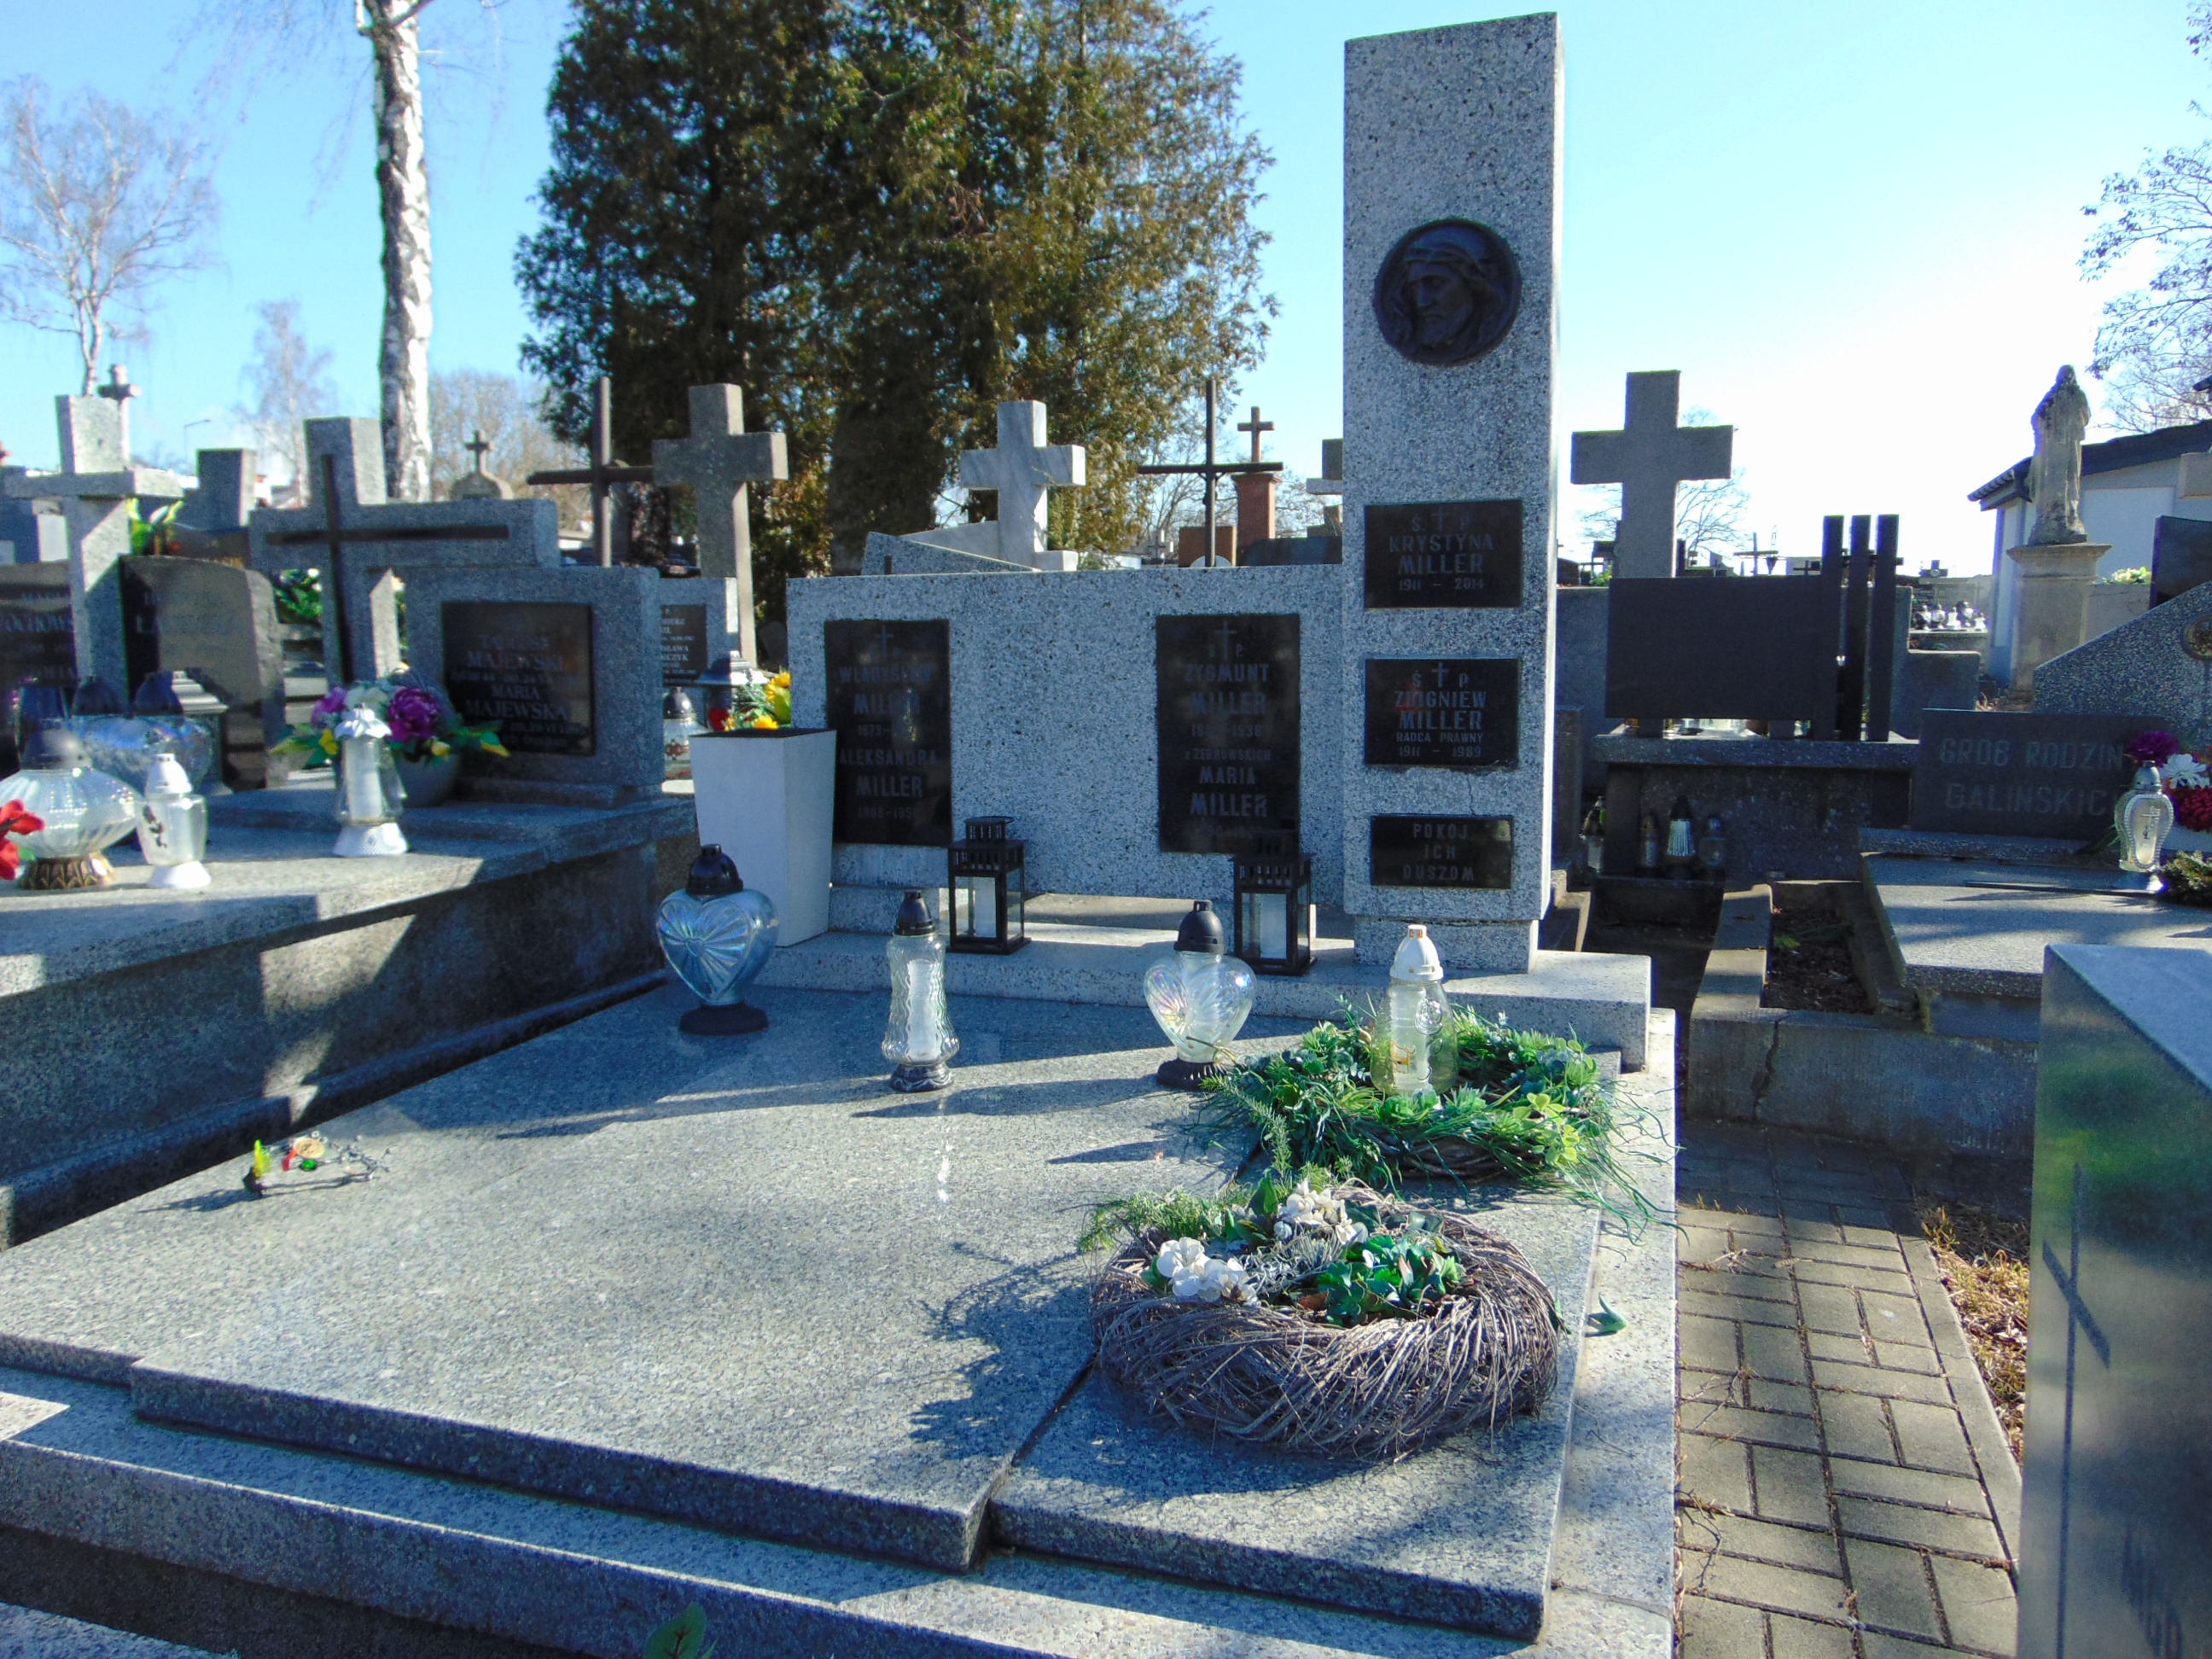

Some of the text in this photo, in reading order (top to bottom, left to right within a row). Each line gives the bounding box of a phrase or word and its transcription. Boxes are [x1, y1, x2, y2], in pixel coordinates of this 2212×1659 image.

[1388, 533, 1495, 553] KRYSTYNA
[1398, 553, 1484, 574] MILLER
[1399, 579, 1421, 591] 1911
[1454, 578, 1484, 590] 2014
[467, 649, 563, 671] MAJEWSKI
[1184, 664, 1269, 683] ZYGMUNT
[491, 684, 541, 700] MARIA
[1394, 690, 1487, 708] ZBIGNIEW
[466, 699, 568, 720] MAJEWSKA
[1190, 691, 1266, 715] MILLER
[1399, 710, 1482, 731] MILLER
[1395, 731, 1483, 743] RADCA PRAWNY
[840, 748, 939, 765] ALEKSANDRA
[1399, 745, 1421, 757] 1911
[1452, 746, 1482, 757] 1989
[1199, 765, 1255, 784] MARIA
[856, 775, 923, 798] MILLER
[1190, 793, 1267, 817] MILLER
[1424, 844, 1456, 860] ICH
[1403, 864, 1476, 882] DUSZOM
